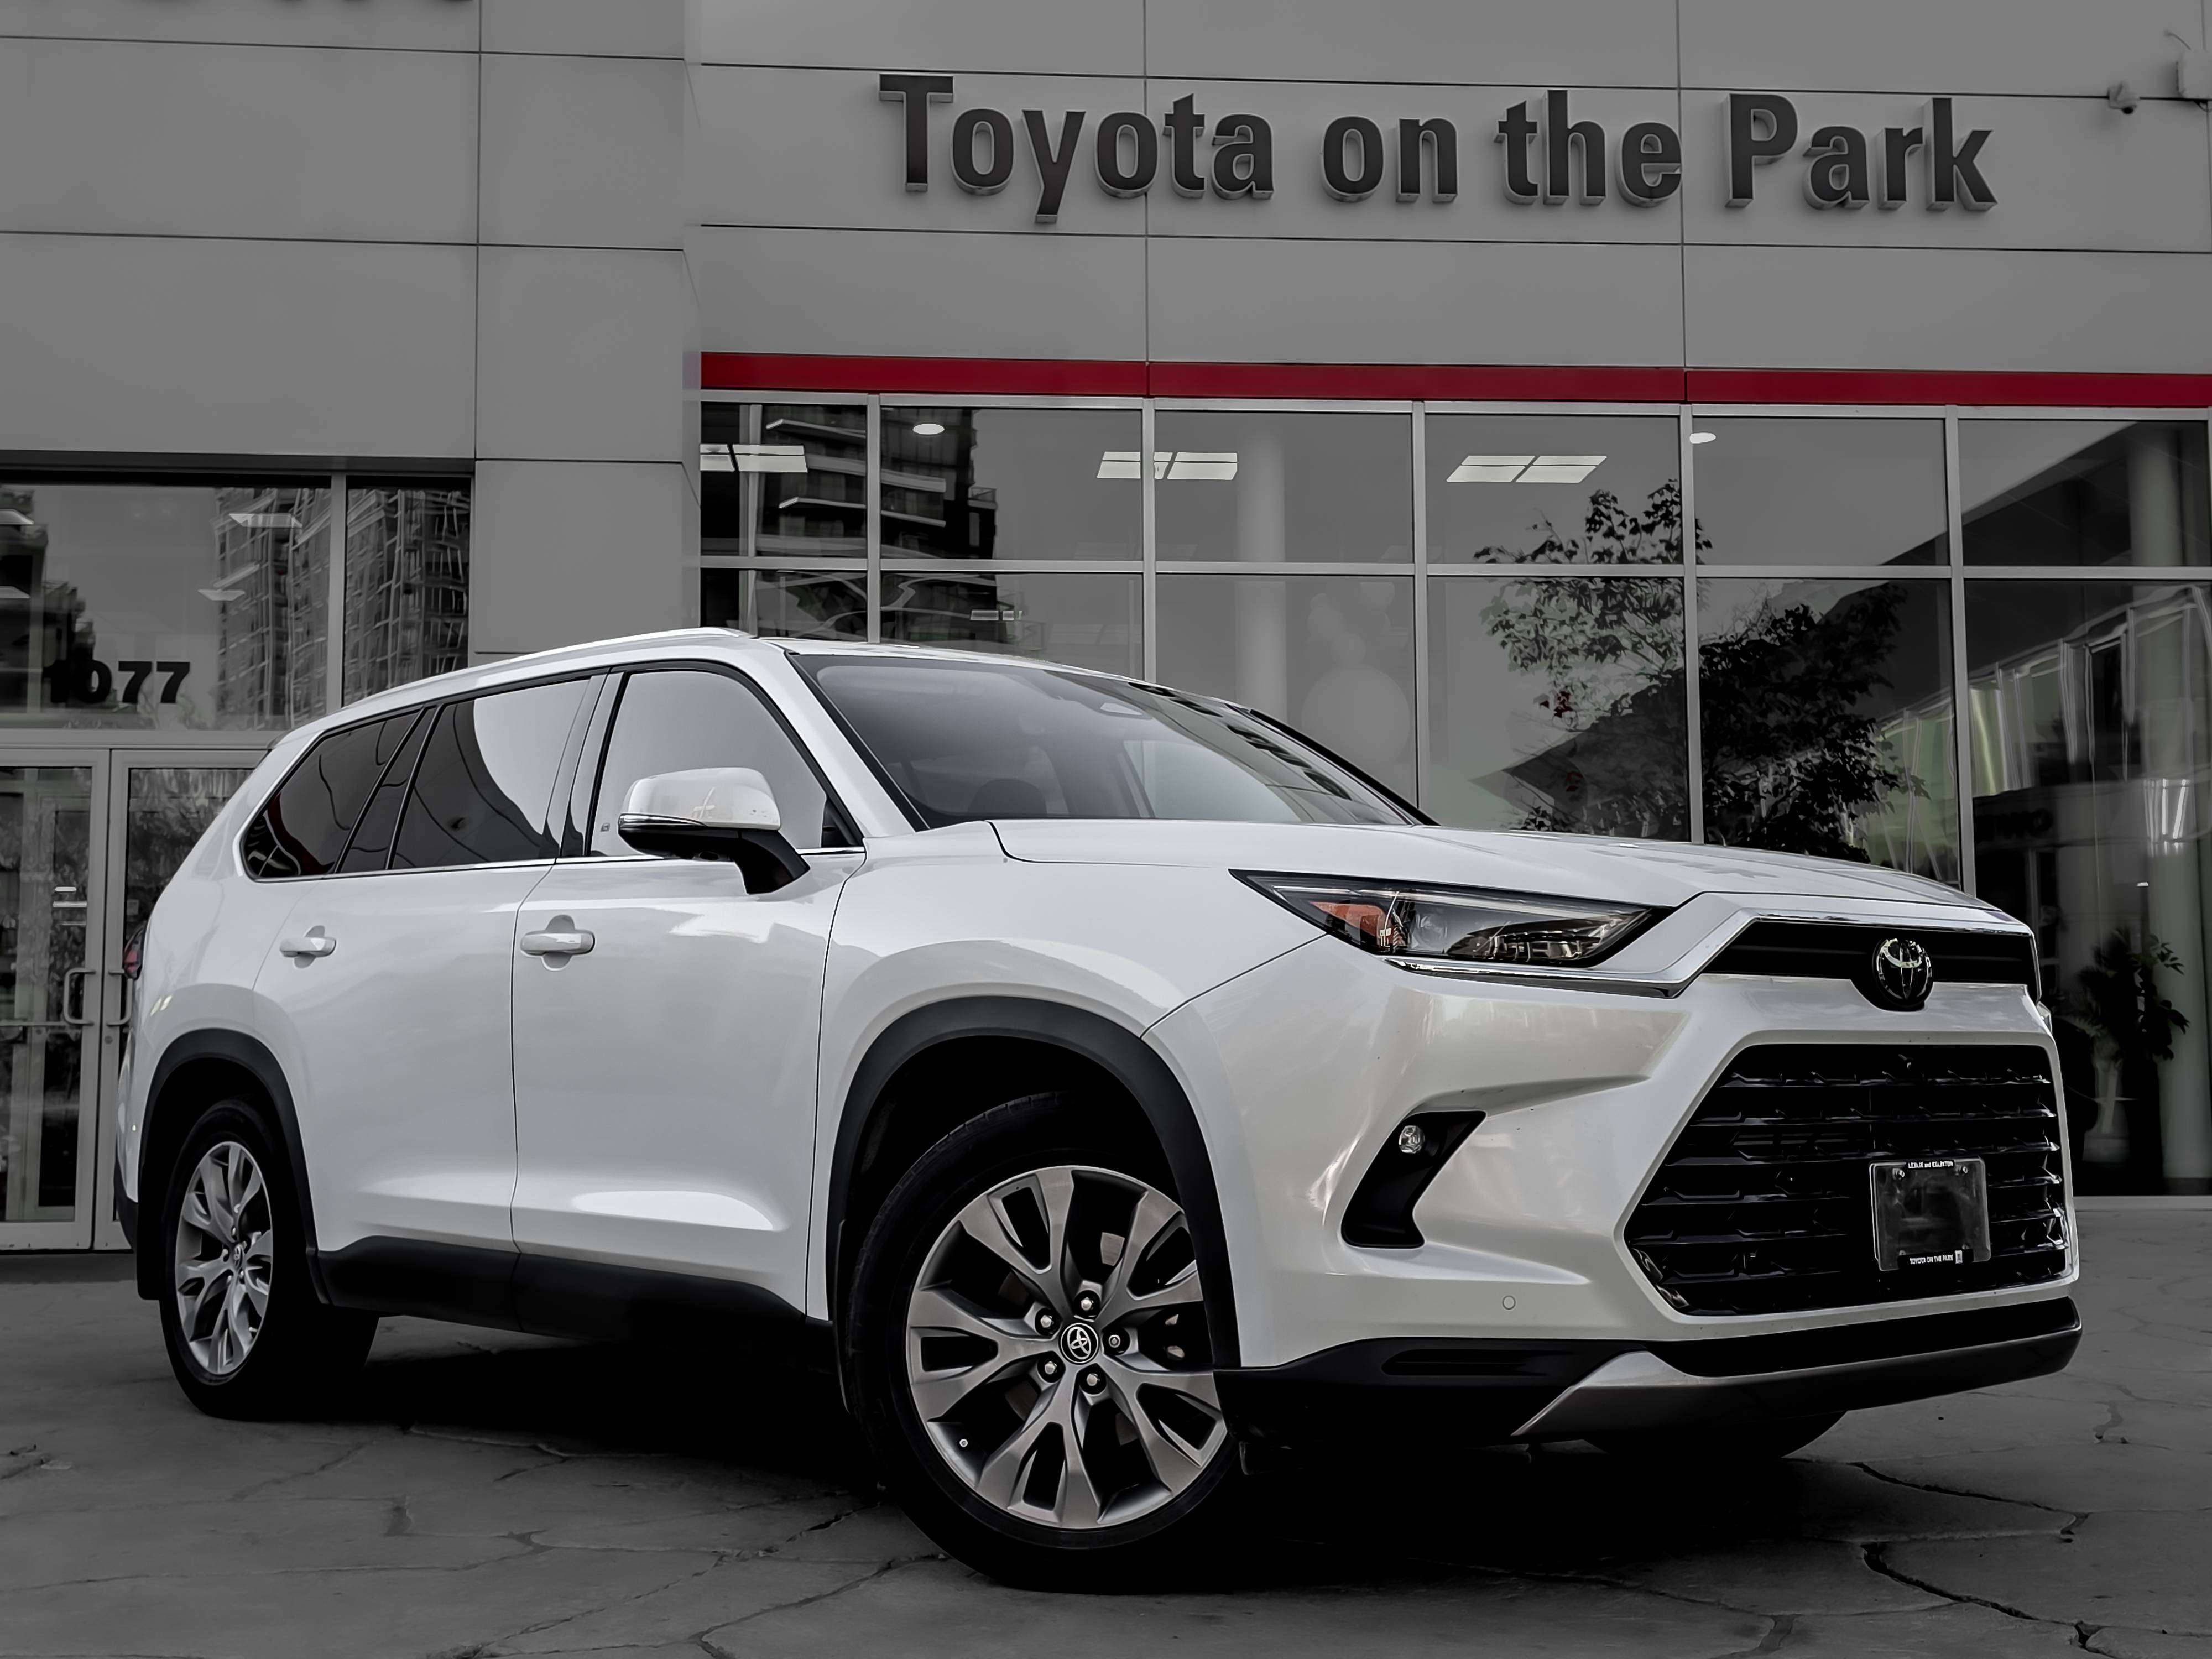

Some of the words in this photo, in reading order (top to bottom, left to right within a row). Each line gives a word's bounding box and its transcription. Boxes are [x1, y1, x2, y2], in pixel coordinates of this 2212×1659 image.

[879, 74, 1274, 223] Toyota
[1321, 116, 1458, 203] on
[1495, 90, 1682, 208] the
[1725, 93, 1998, 211] Park
[43, 660, 190, 703] 1077
